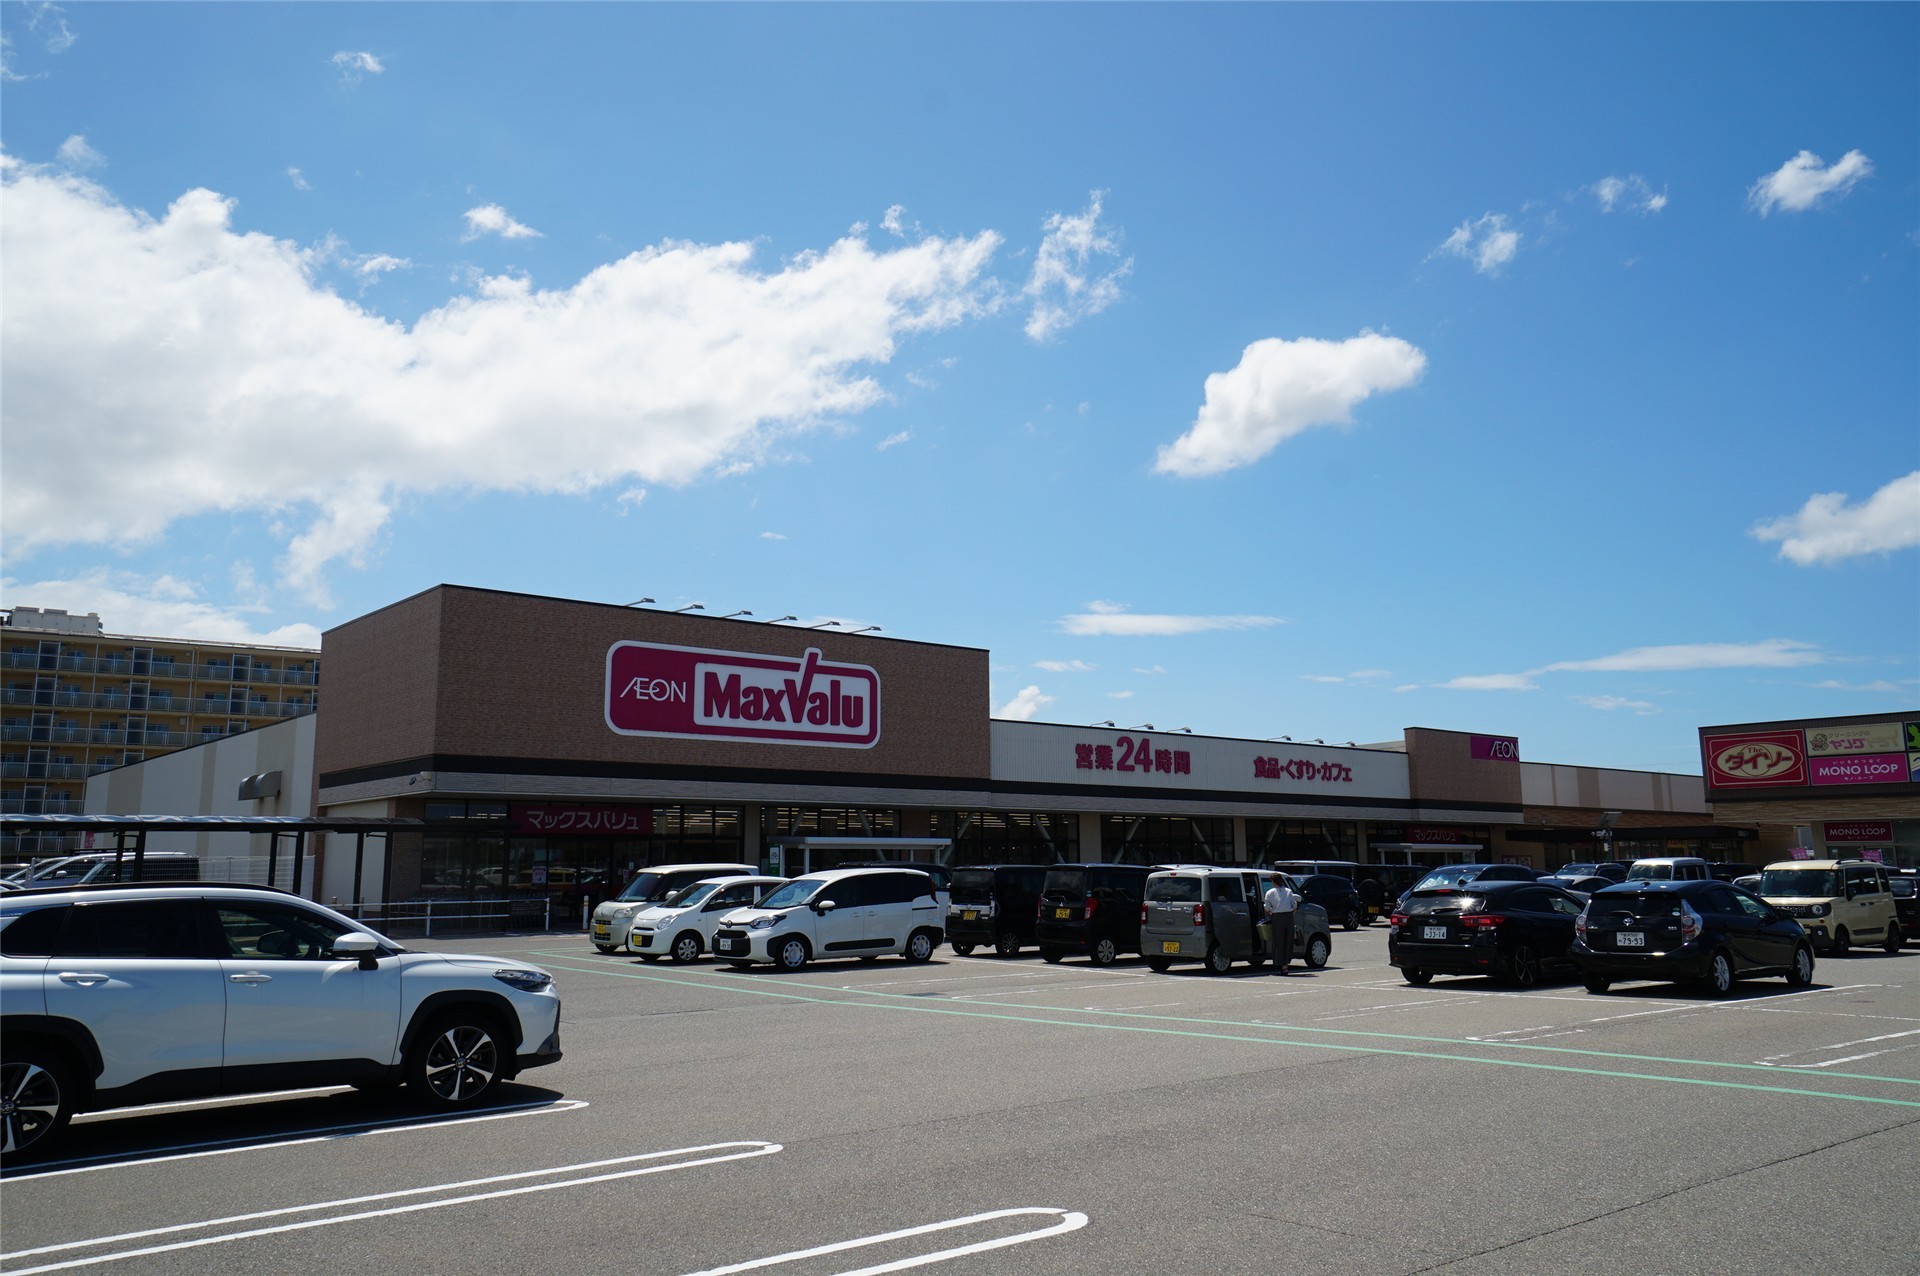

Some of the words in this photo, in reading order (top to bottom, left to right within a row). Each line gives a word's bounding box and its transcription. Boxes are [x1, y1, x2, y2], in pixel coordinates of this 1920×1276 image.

[703, 652, 864, 728] MaxValu
[1075, 736, 1191, 775] 営業24時間
[1747, 746, 1763, 754] The
[1725, 751, 1793, 771] ダイソー
[1819, 765, 1861, 776] MONO
[1864, 763, 1899, 774] LOOP
[527, 810, 640, 830] マックスバリュ
[1413, 829, 1457, 841] マックスバリュ
[1829, 828, 1860, 836] MONO
[1862, 827, 1886, 835] LOOP
